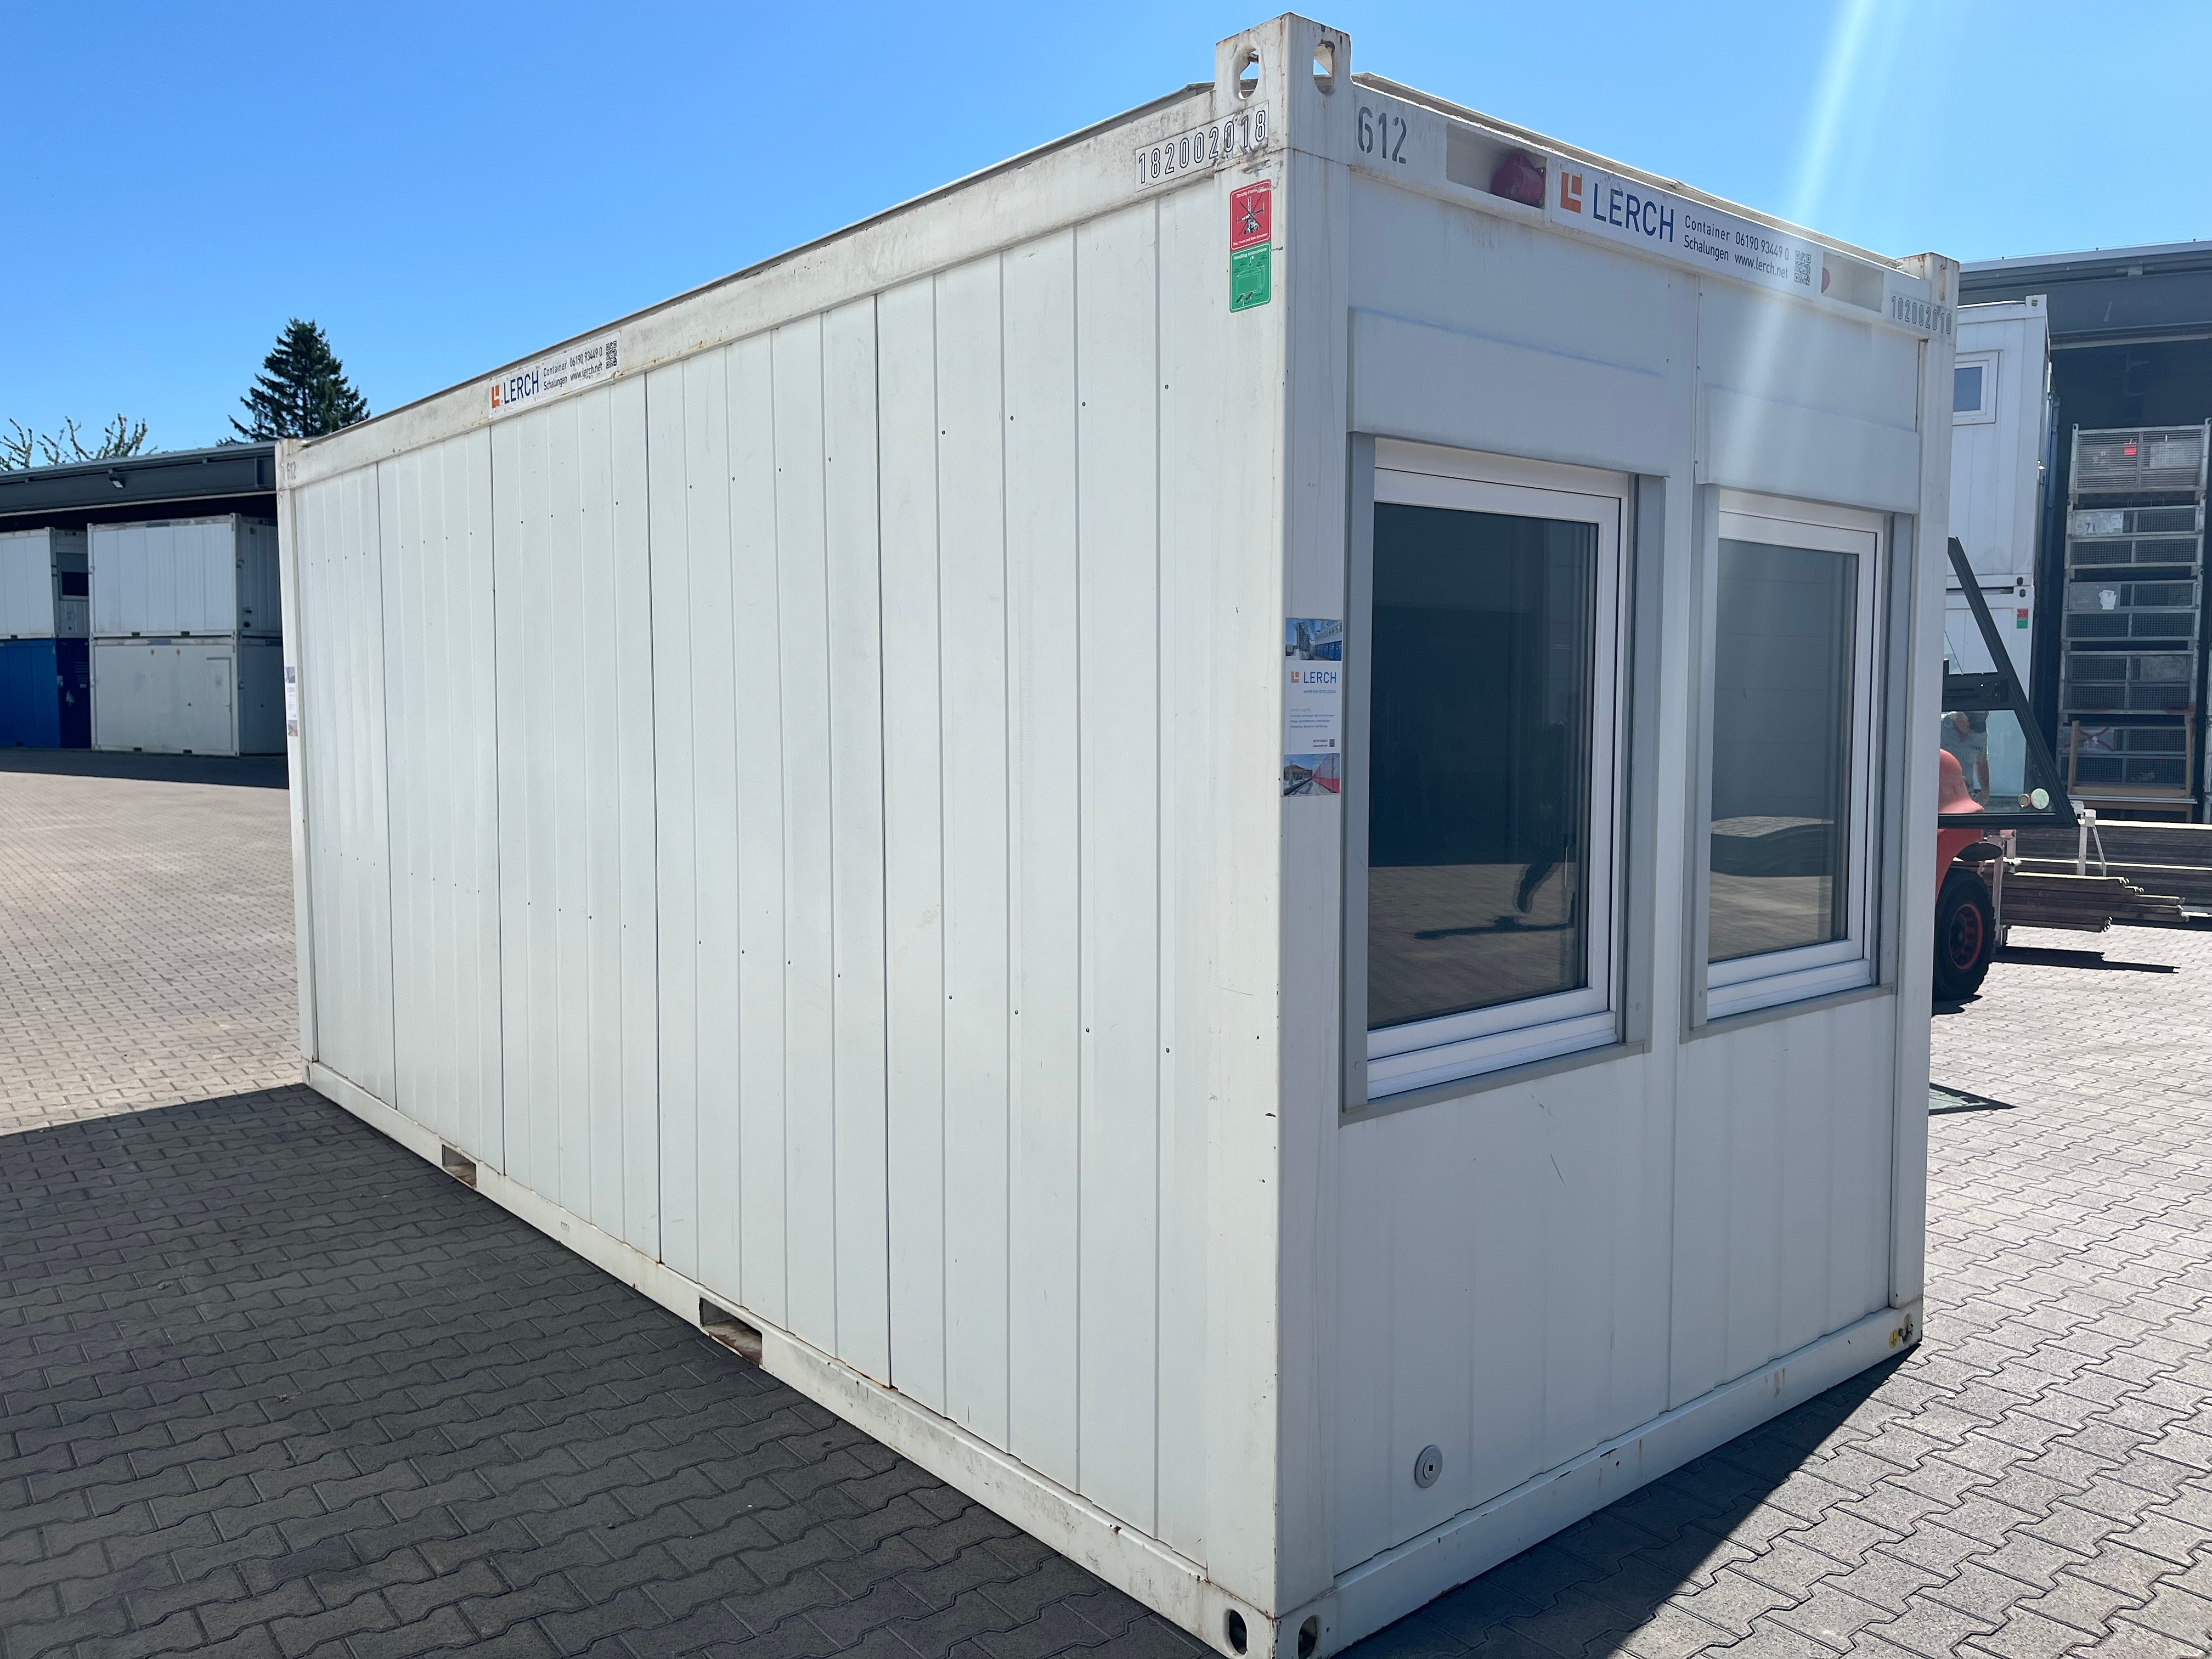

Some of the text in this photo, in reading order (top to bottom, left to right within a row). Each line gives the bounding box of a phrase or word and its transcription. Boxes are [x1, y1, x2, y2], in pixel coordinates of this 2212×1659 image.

[1138, 110, 1266, 184] 182002018
[1358, 106, 1407, 164] 612
[1593, 183, 1674, 242] LERCH
[1684, 235, 1788, 279] Schalungen www.lerch.net
[1685, 215, 1789, 261] Container 06190 93449 0
[1892, 296, 1951, 334] 182002018
[543, 361, 567, 377] Container
[569, 354, 584, 367] 06190
[584, 347, 598, 362] 93449
[544, 362, 603, 391] Schalungen www.lerch.net
[504, 370, 539, 404] LERCH
[1304, 672, 1337, 684] LERCH
